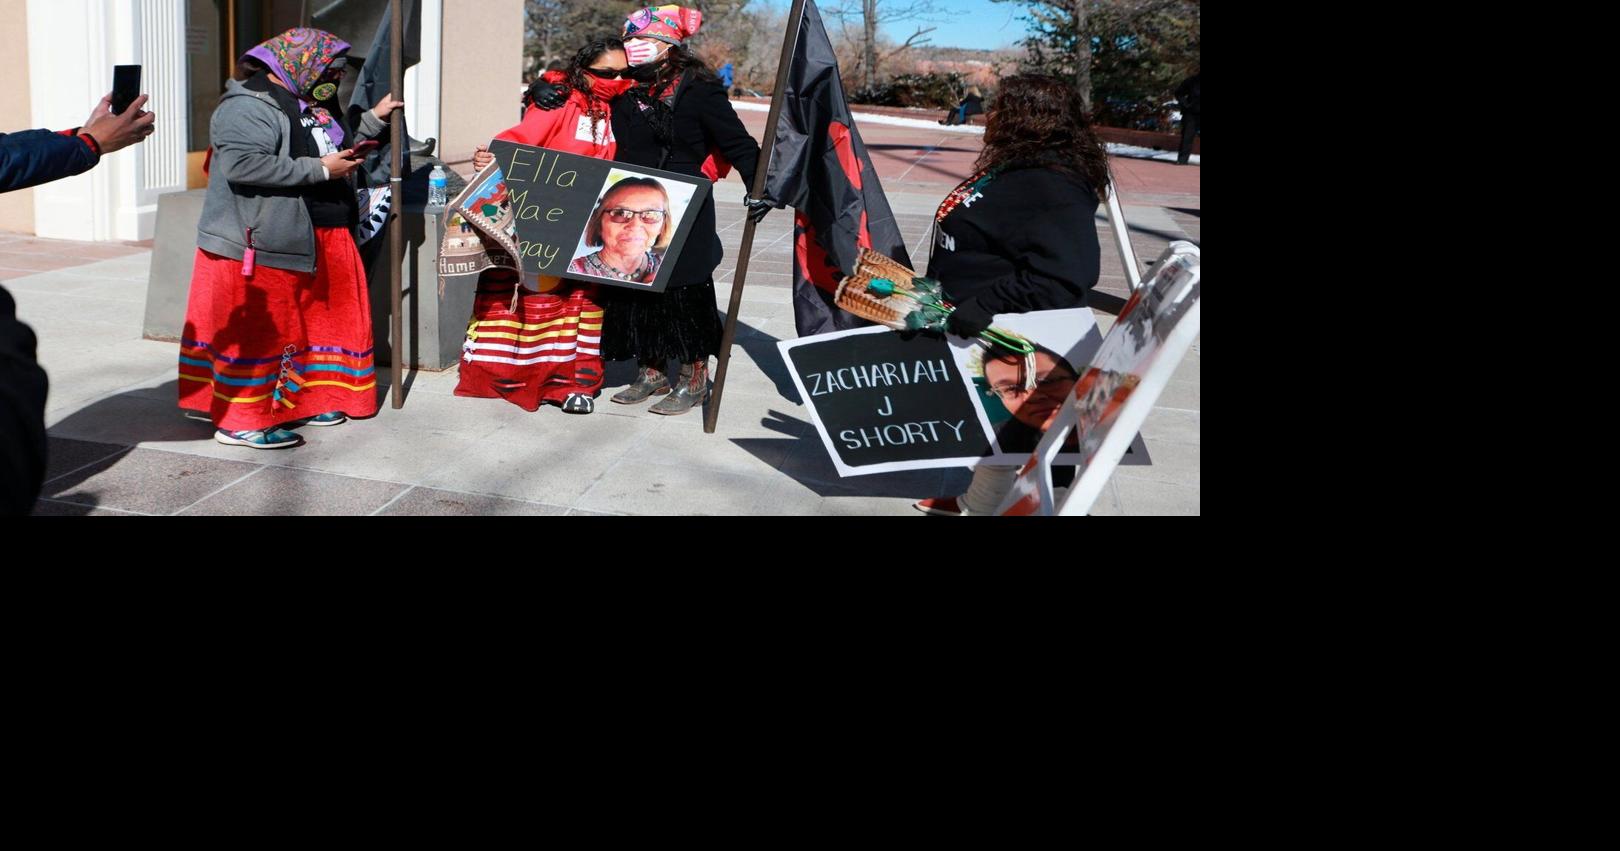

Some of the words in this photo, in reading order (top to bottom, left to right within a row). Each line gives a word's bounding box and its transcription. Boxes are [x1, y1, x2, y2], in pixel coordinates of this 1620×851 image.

[506, 148, 577, 187] Ella
[508, 188, 564, 222] Mae
[439, 257, 476, 274] Home
[806, 359, 950, 397] ZACHARIAH
[877, 395, 893, 417] J
[839, 419, 965, 450] SHORTY
